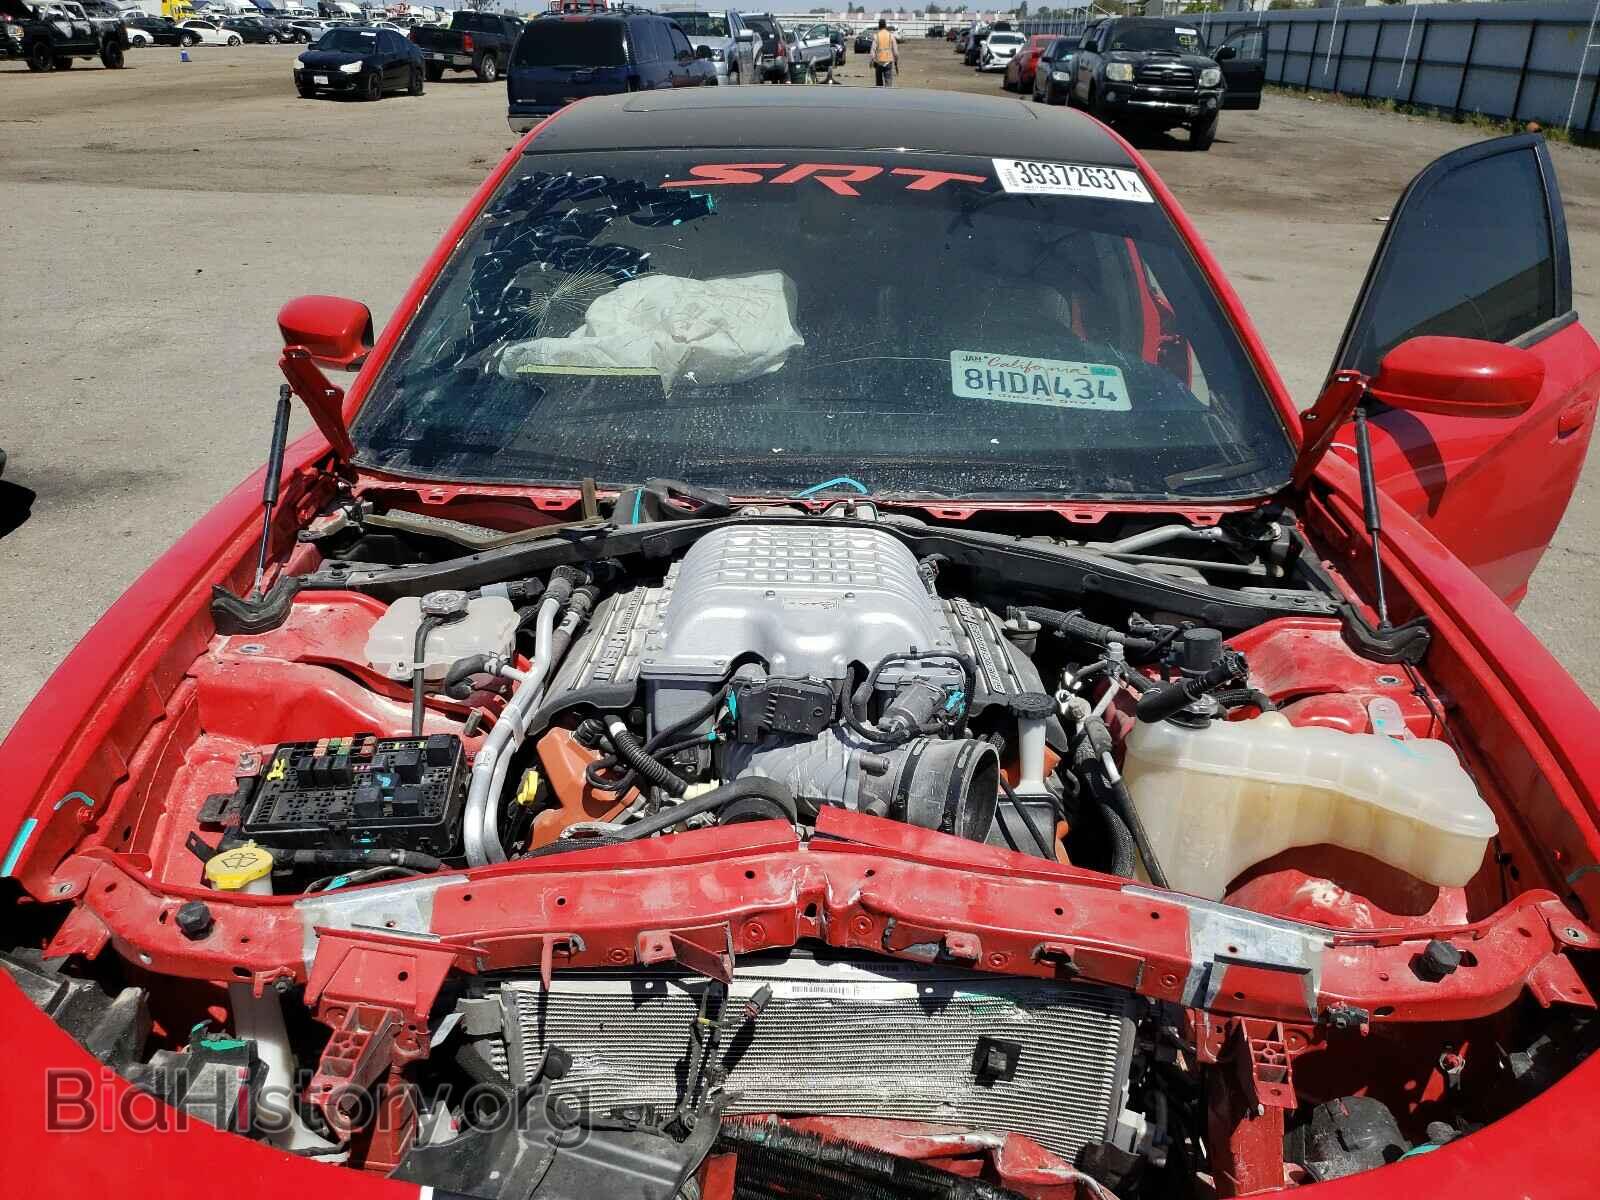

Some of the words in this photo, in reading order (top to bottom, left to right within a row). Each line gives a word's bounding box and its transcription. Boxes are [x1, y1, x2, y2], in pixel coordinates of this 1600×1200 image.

[658, 163, 987, 196] SRT
[1014, 161, 1127, 192] 39372631
[962, 355, 983, 363] JAN
[986, 356, 1082, 374] California
[964, 368, 1118, 402] 8HDA434
